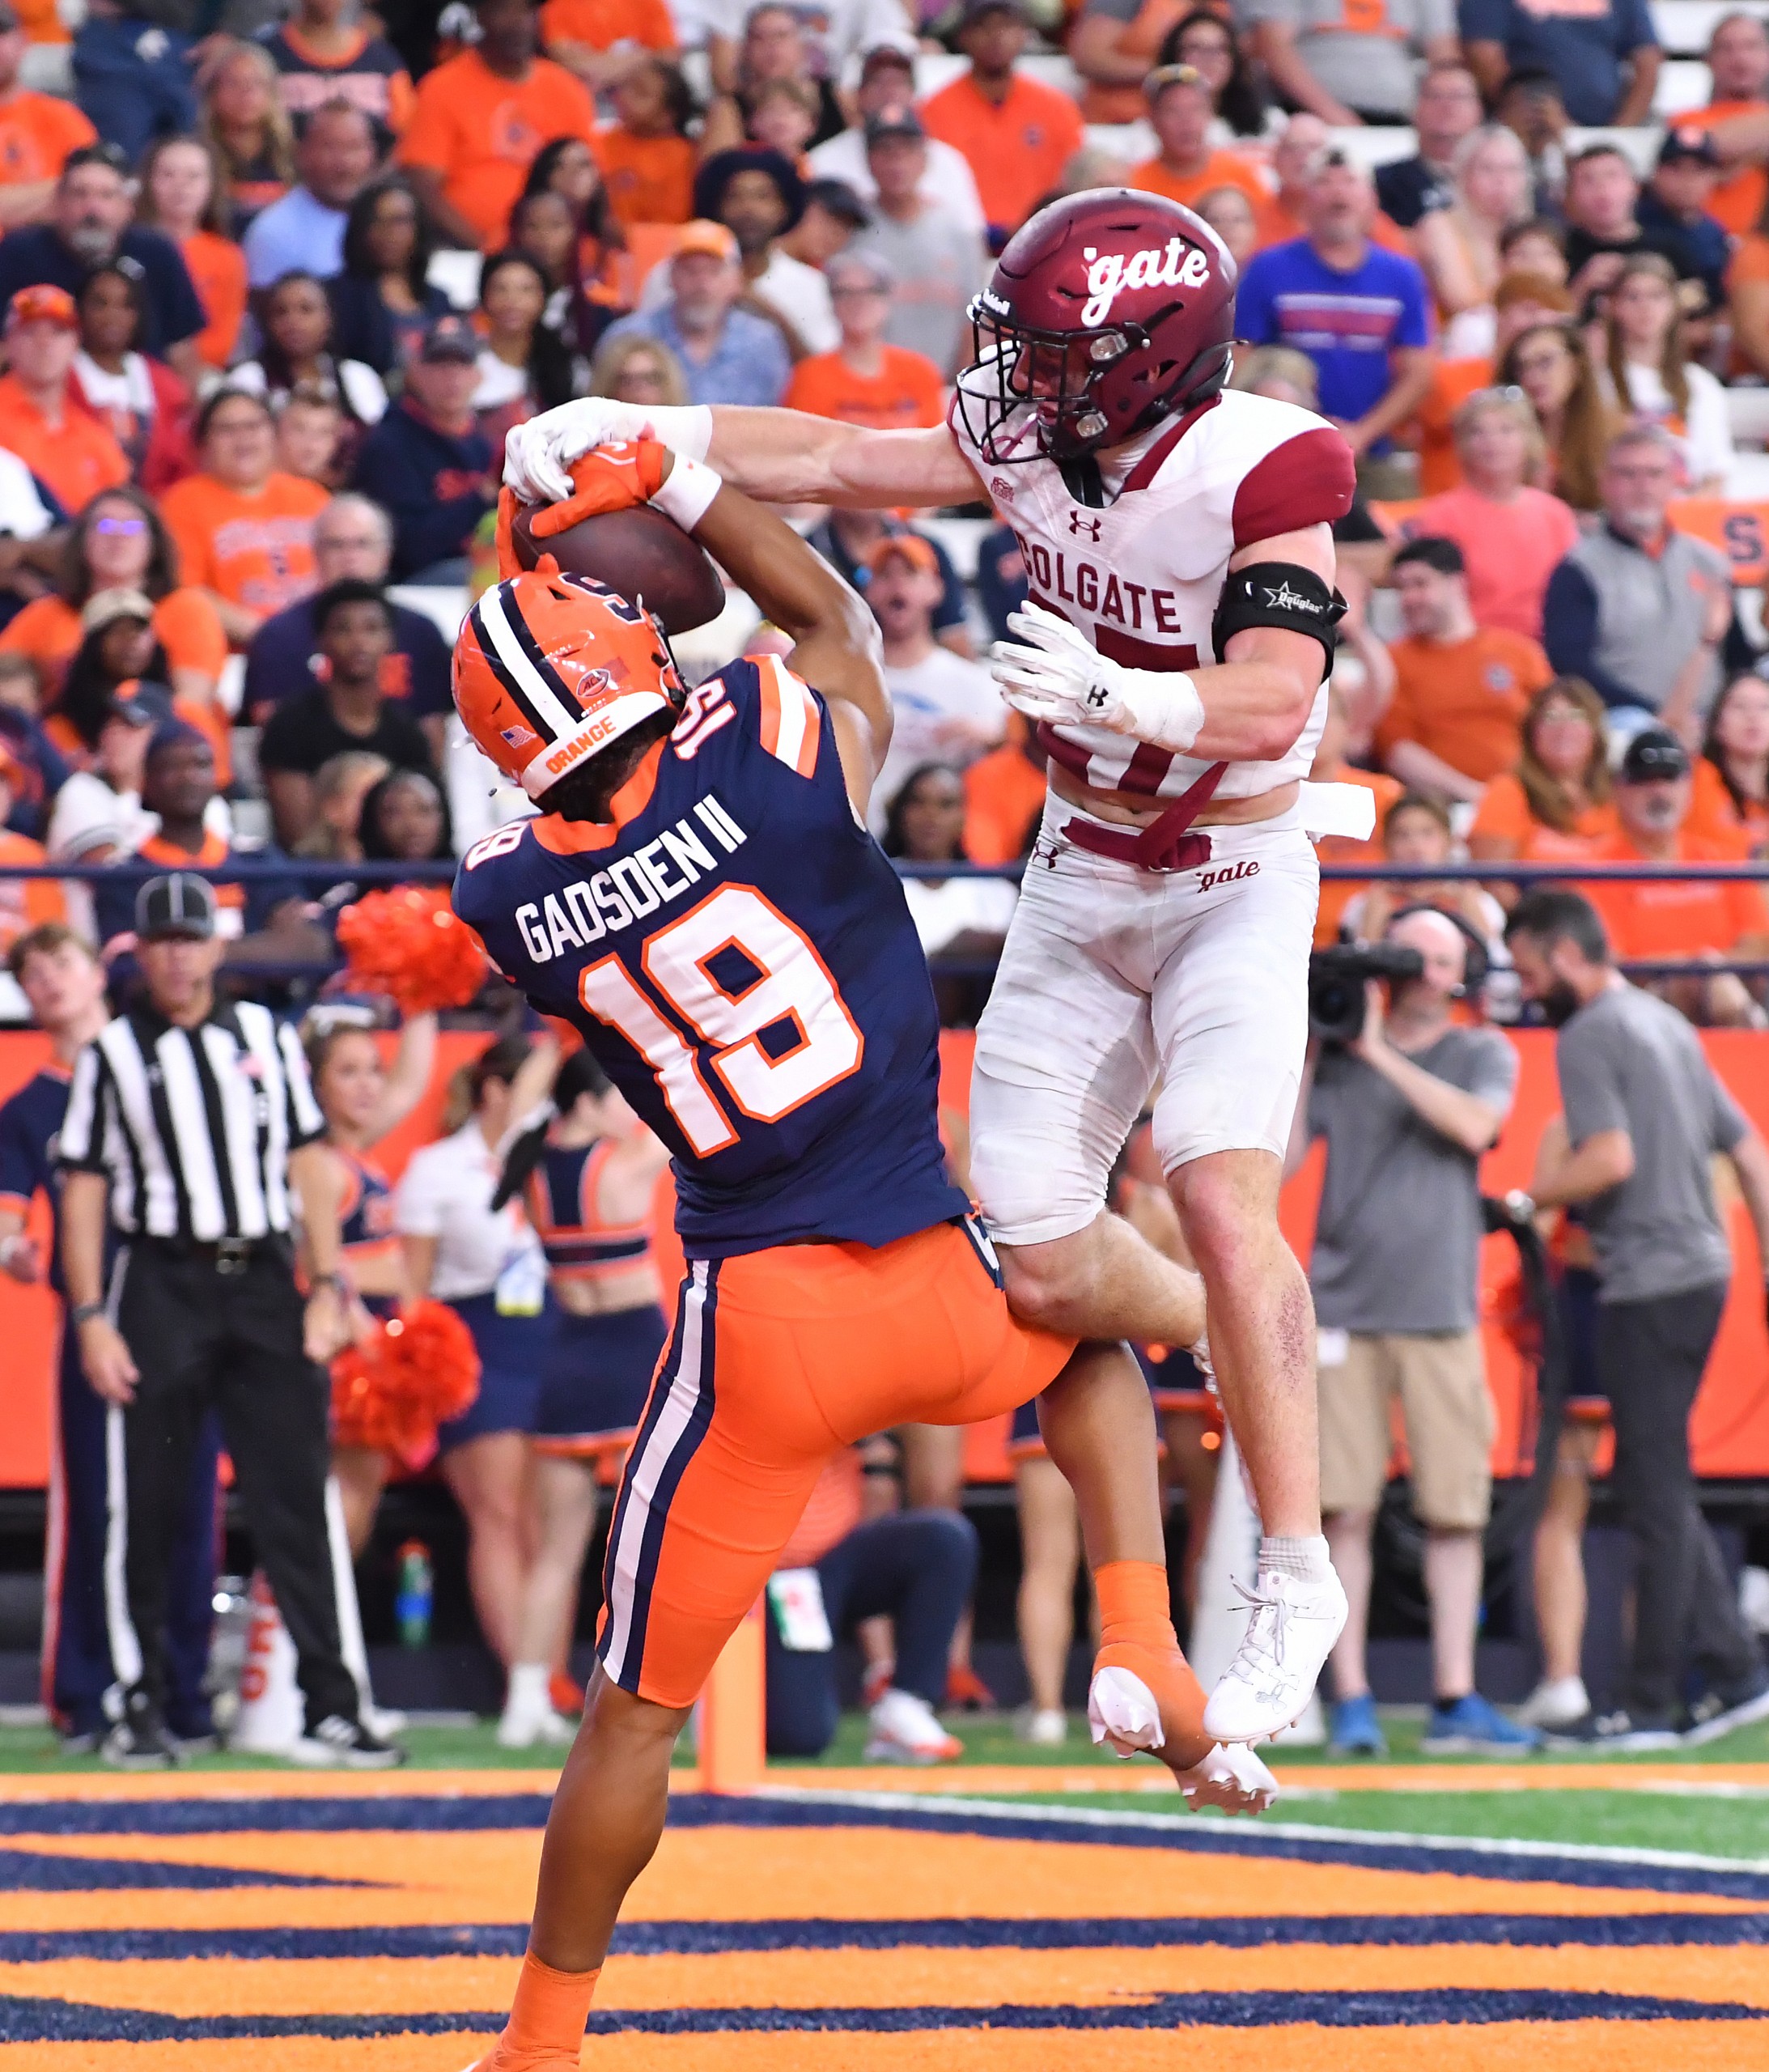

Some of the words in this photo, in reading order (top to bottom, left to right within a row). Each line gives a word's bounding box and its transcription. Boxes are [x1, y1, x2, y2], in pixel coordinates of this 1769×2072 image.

[1724, 512, 1762, 563] S
[1013, 529, 1181, 634] COLGATE
[1278, 591, 1321, 614] Douglas
[545, 715, 617, 775] ORANGE
[515, 818, 719, 964] GADSDEN
[692, 792, 749, 854] II
[577, 880, 865, 1160] 19
